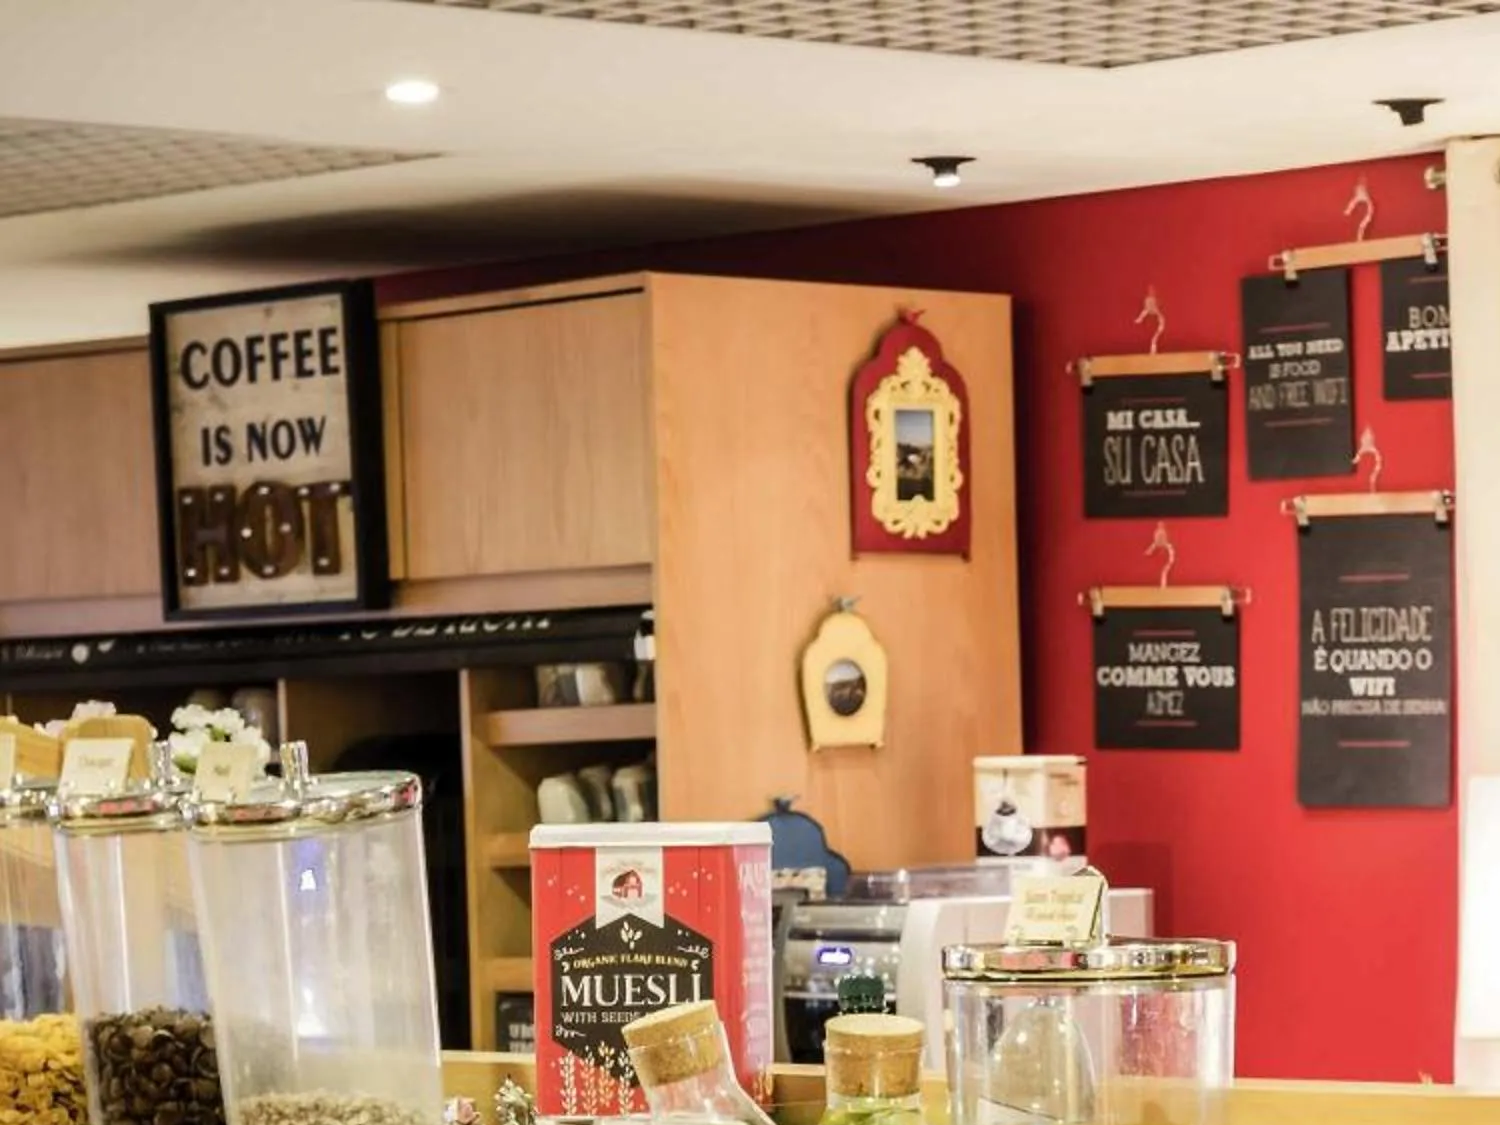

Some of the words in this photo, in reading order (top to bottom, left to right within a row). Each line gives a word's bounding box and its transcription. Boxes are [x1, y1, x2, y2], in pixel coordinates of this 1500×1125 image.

[180, 326, 341, 391] COFFEE
[1248, 344, 1274, 359] ALL
[1282, 359, 1321, 377] FOOD
[1106, 411, 1134, 430] MI
[202, 425, 233, 467] IS
[246, 415, 328, 462] NOW
[1104, 436, 1132, 485] SU
[1140, 434, 1205, 484] CASA
[178, 479, 353, 587] HOT
[1311, 609, 1326, 643] A
[1330, 605, 1433, 642] FELICIDADE
[1128, 642, 1201, 663] MANGEZ
[1330, 648, 1413, 673] QUANDO
[1415, 648, 1433, 671] O
[1096, 665, 1179, 687] COMME
[1183, 665, 1236, 687] VOUS
[573, 955, 618, 969] ORGANIC
[560, 973, 702, 1007] MUESLI
[561, 1011, 597, 1024] WITH
